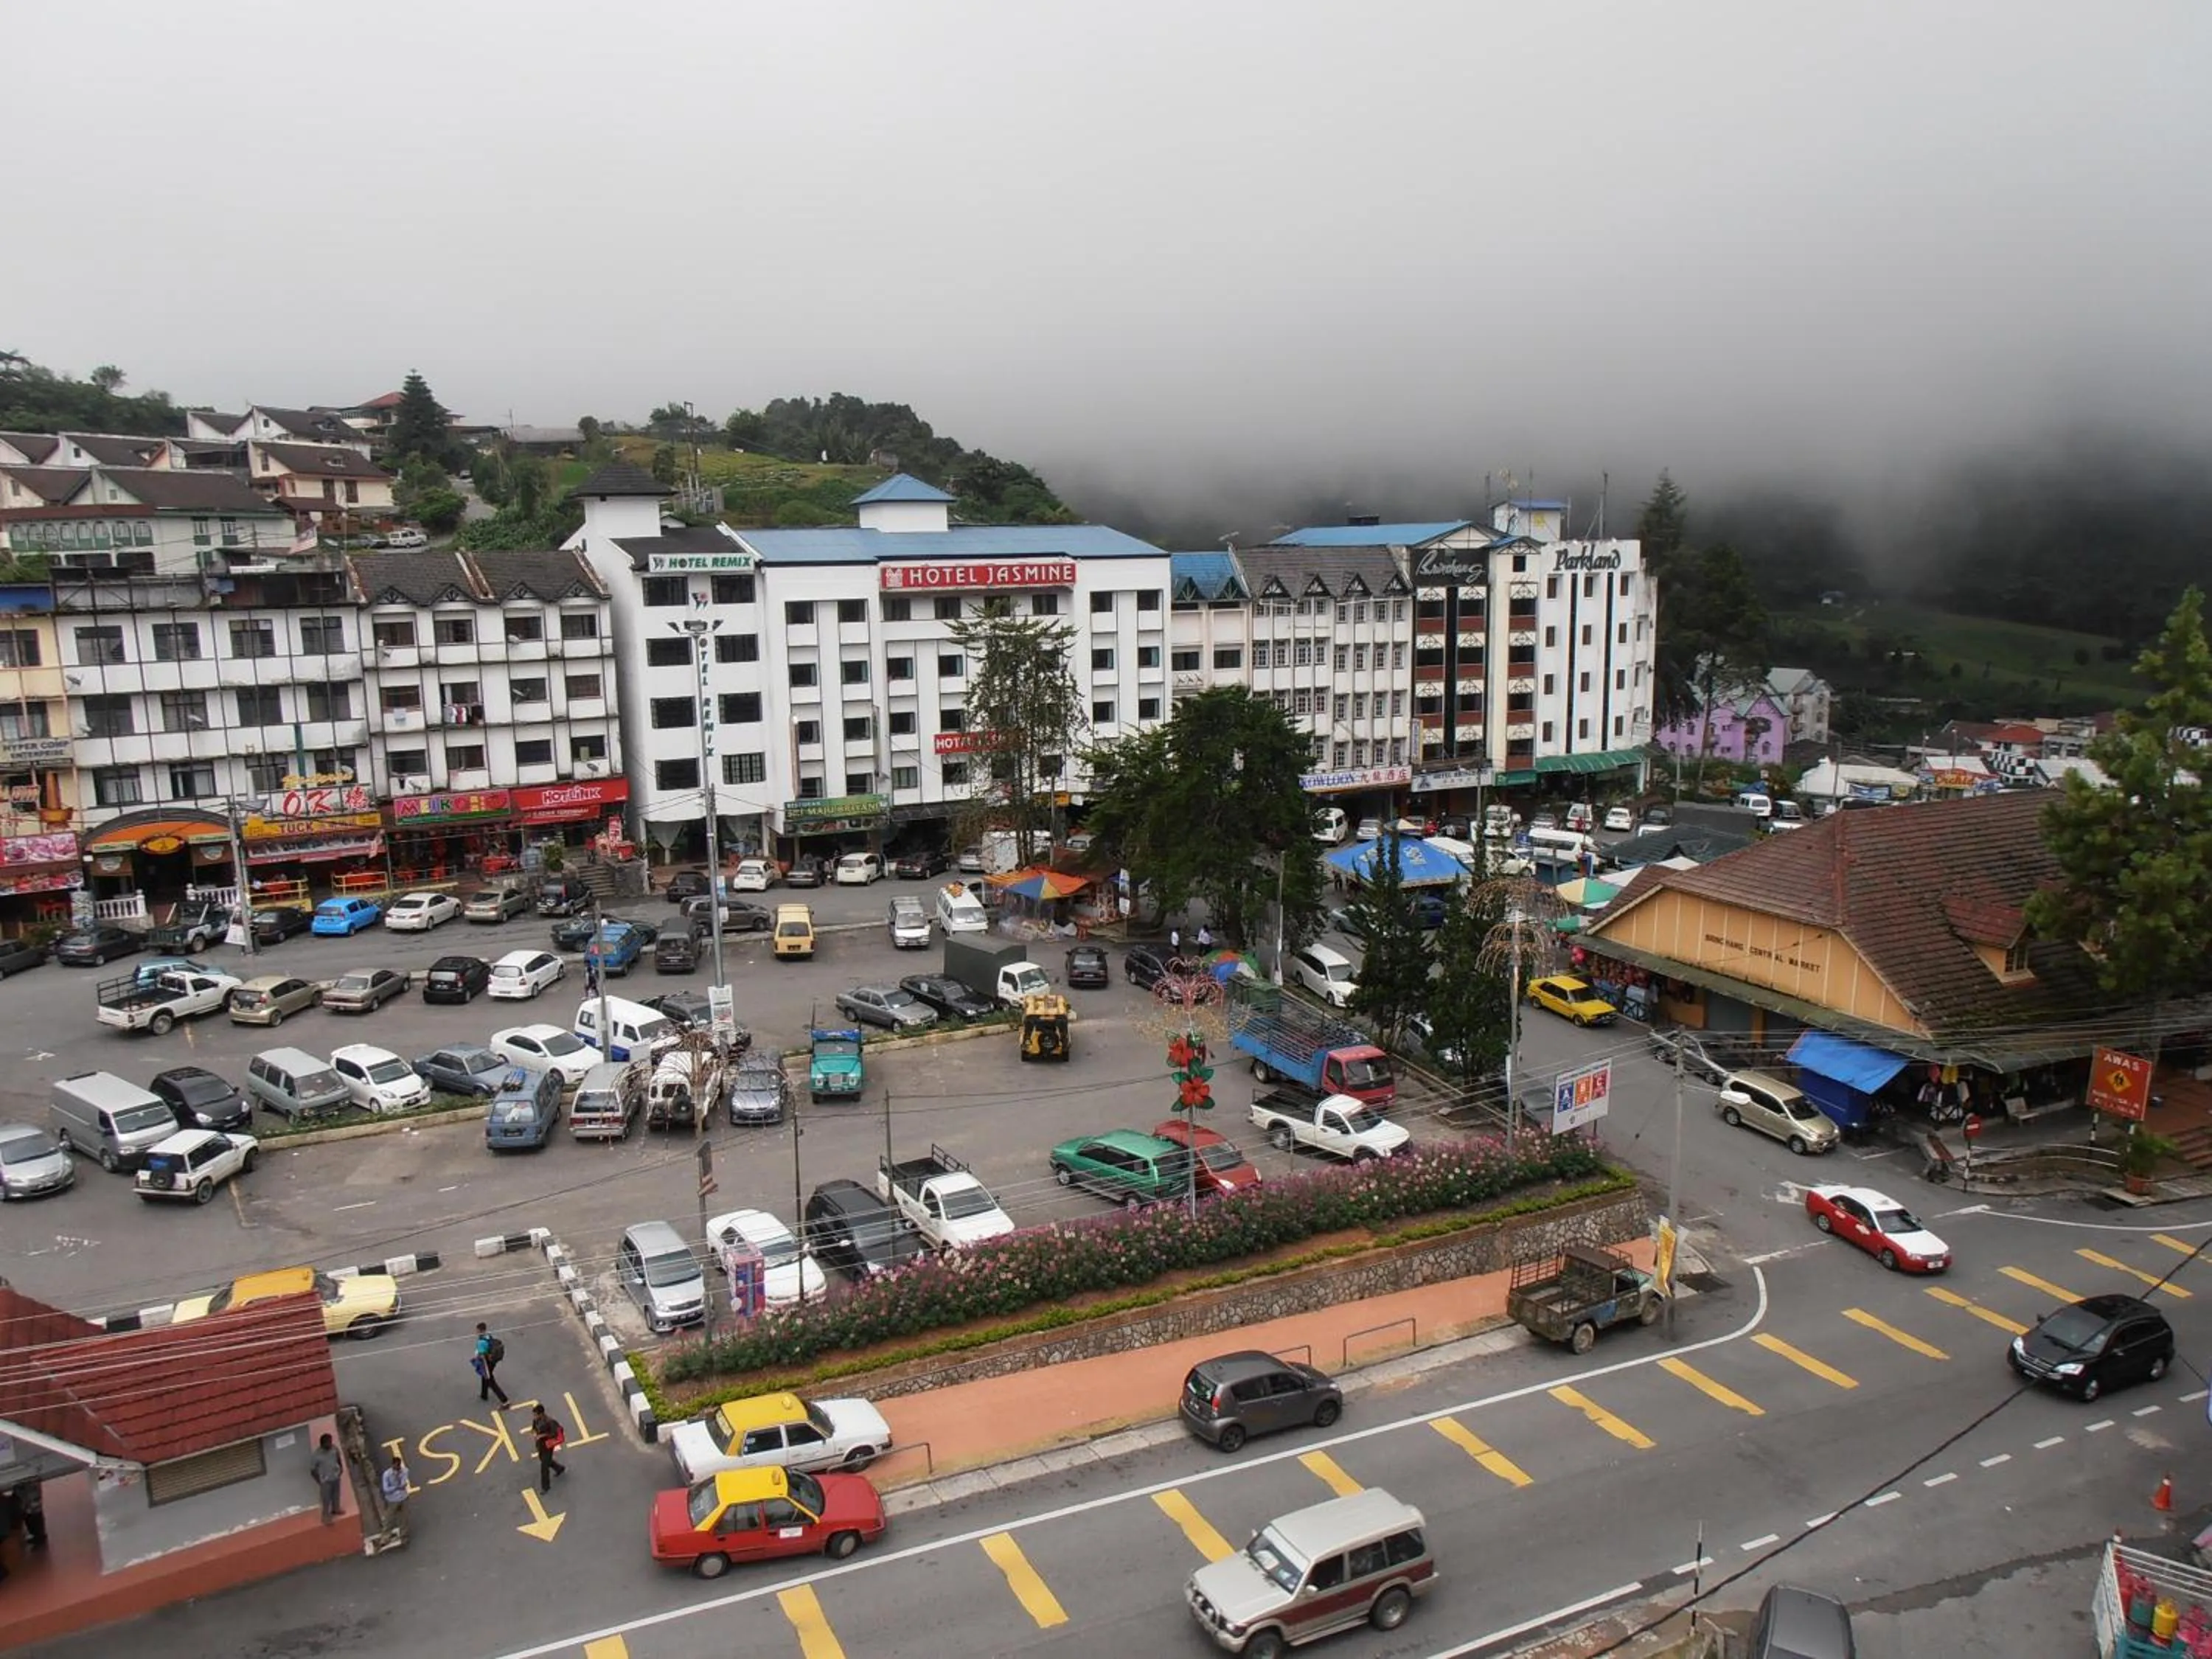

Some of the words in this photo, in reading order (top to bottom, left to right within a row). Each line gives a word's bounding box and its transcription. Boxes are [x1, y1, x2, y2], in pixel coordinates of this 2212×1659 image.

[669, 557, 708, 568] HOTEL
[712, 556, 751, 567] REMIX
[1553, 544, 1621, 571] Parkland
[909, 567, 977, 584] HOTEL
[987, 565, 1074, 584] JASMINE
[703, 697, 714, 757] REMIX
[283, 790, 333, 816] OK
[279, 822, 314, 834] TUCK
[1788, 956, 1821, 974] MARKET
[2104, 1053, 2140, 1071] AWAS
